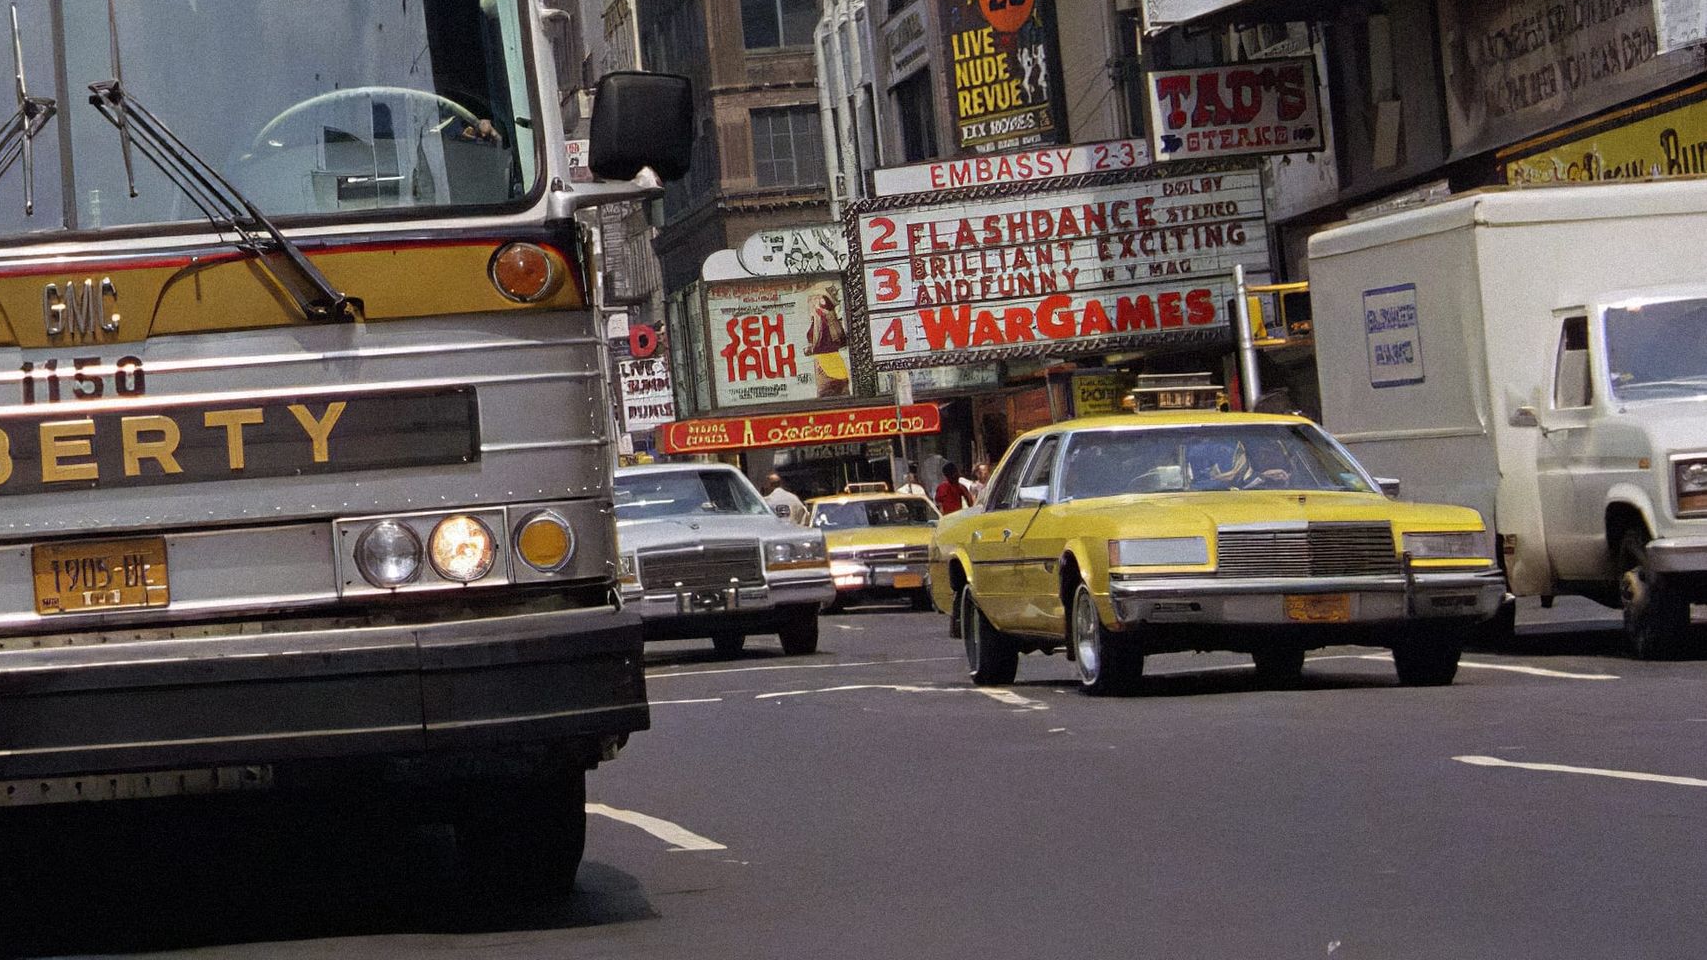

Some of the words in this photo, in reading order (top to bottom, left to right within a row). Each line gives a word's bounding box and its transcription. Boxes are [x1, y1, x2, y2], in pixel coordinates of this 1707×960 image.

[951, 27, 995, 61] LIVE
[954, 51, 1010, 90] NUDE
[957, 78, 1023, 118] REVUE
[1155, 65, 1307, 130] TAD'S
[1185, 125, 1289, 153] STEAKS
[929, 148, 1073, 190] EMBASSY
[1161, 176, 1225, 197] DOLBY
[867, 217, 897, 253] 2
[907, 196, 1158, 256] FLASHDANCE
[910, 240, 1076, 281] BRILLIANT
[1097, 221, 1247, 262] EXCITING
[43, 276, 121, 336] GMC
[875, 267, 902, 303] 3
[915, 275, 976, 308] AND
[978, 265, 1080, 302] FUNNY
[878, 316, 908, 352] 4
[19, 355, 146, 405] 1150
